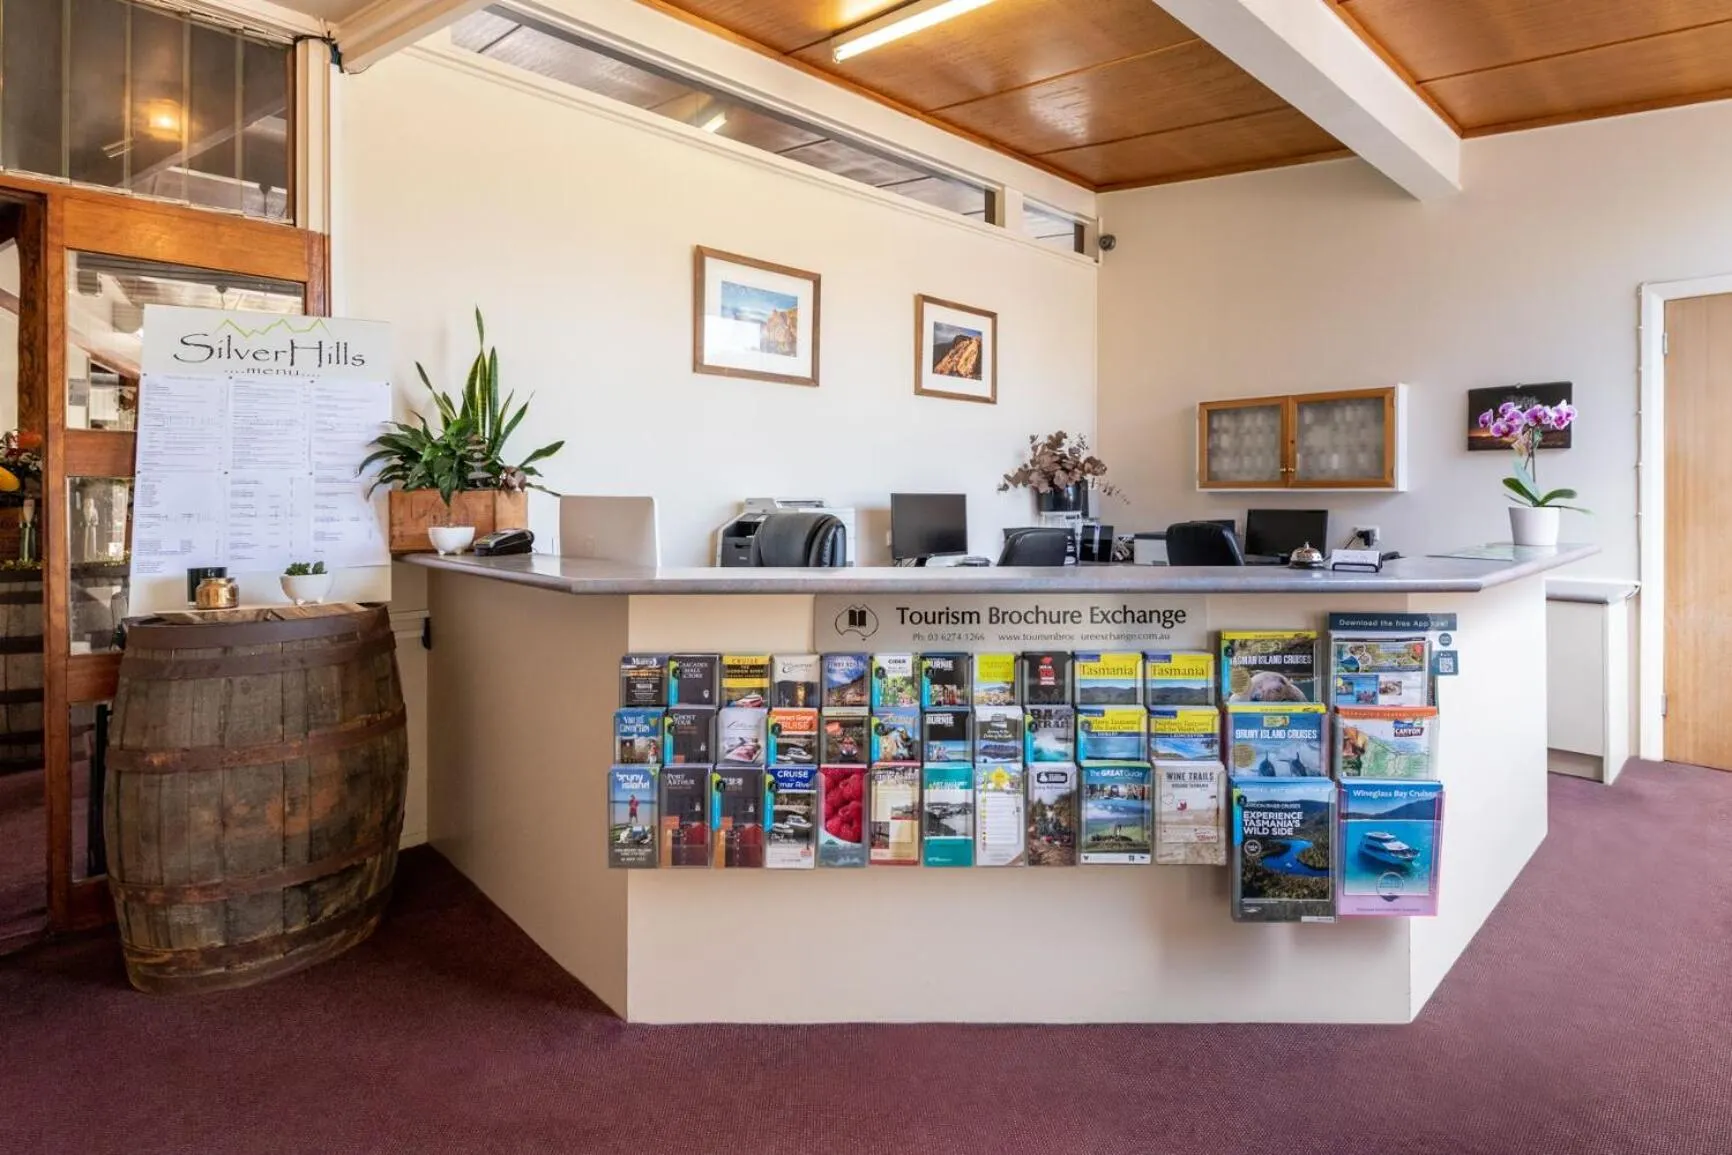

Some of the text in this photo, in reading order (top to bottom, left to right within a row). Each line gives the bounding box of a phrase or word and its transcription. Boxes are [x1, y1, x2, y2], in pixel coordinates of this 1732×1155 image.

[896, 604, 1187, 630] Tourism Brochure Exchange
[1338, 619, 1378, 627] Download
[1413, 620, 1430, 629] App
[1232, 654, 1312, 665] ASMAN ISLAND CRUISES
[1080, 664, 1134, 676] Tasmania
[1151, 664, 1205, 677] Tasmania
[1235, 729, 1317, 739] BRUNY ISLAND CRUISES
[1394, 728, 1422, 736] CANYON
[776, 770, 809, 778] CRUISE
[1100, 769, 1125, 777] GREAT
[1166, 772, 1215, 781] WINE TRAILS
[1352, 789, 1393, 799] Wineglass
[1393, 789, 1408, 799] Bay
[1243, 811, 1304, 820] EXPERIENCE
[1244, 819, 1301, 828] TASMANIA'S
[1243, 827, 1294, 836] WILD SIDE
